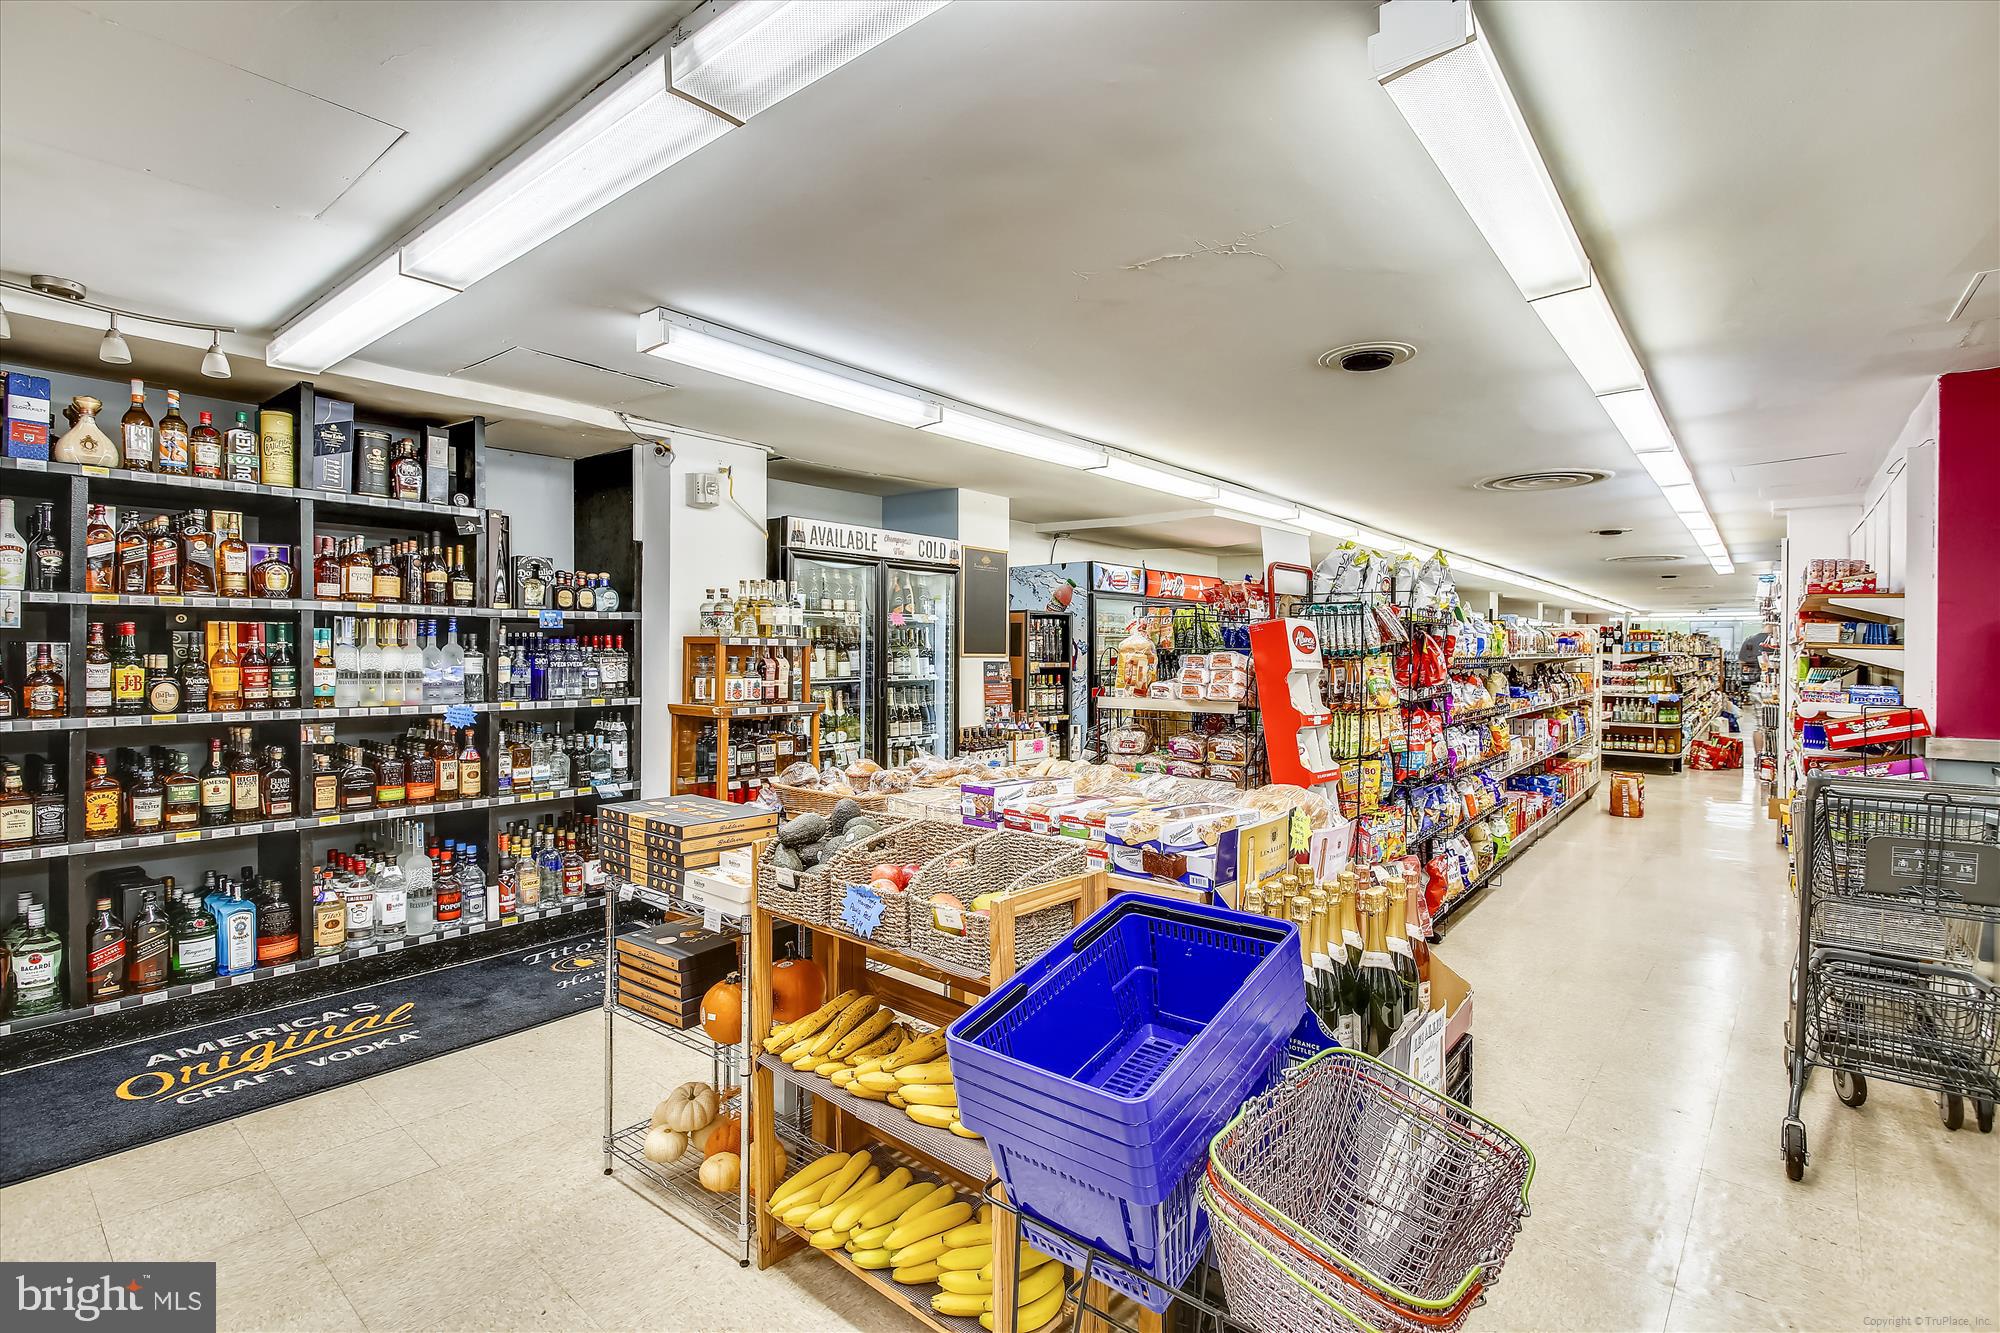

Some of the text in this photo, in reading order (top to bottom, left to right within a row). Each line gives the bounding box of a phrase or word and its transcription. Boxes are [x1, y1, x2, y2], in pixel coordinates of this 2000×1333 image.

[236, 431, 252, 481] BUSKER
[810, 526, 878, 552] AVAILABLE
[918, 540, 946, 560] COLD
[120, 675, 142, 692] J&B
[1851, 718, 1888, 732] Skittles
[88, 793, 118, 804] FIREBALL
[2, 810, 13, 818] JACK
[37, 806, 47, 815] JACK
[322, 912, 341, 920] Tito's
[104, 947, 120, 957] LABEL
[137, 939, 166, 954] BLACK LABEL
[184, 947, 212, 956] Tanqueray
[21, 961, 50, 972] BACARDÍ
[146, 1001, 380, 1066] AMERICA'S
[115, 1002, 414, 1100] Original
[1293, 1038, 1320, 1051] FRANCE
[177, 1031, 412, 1105] CRAFT VODKA
